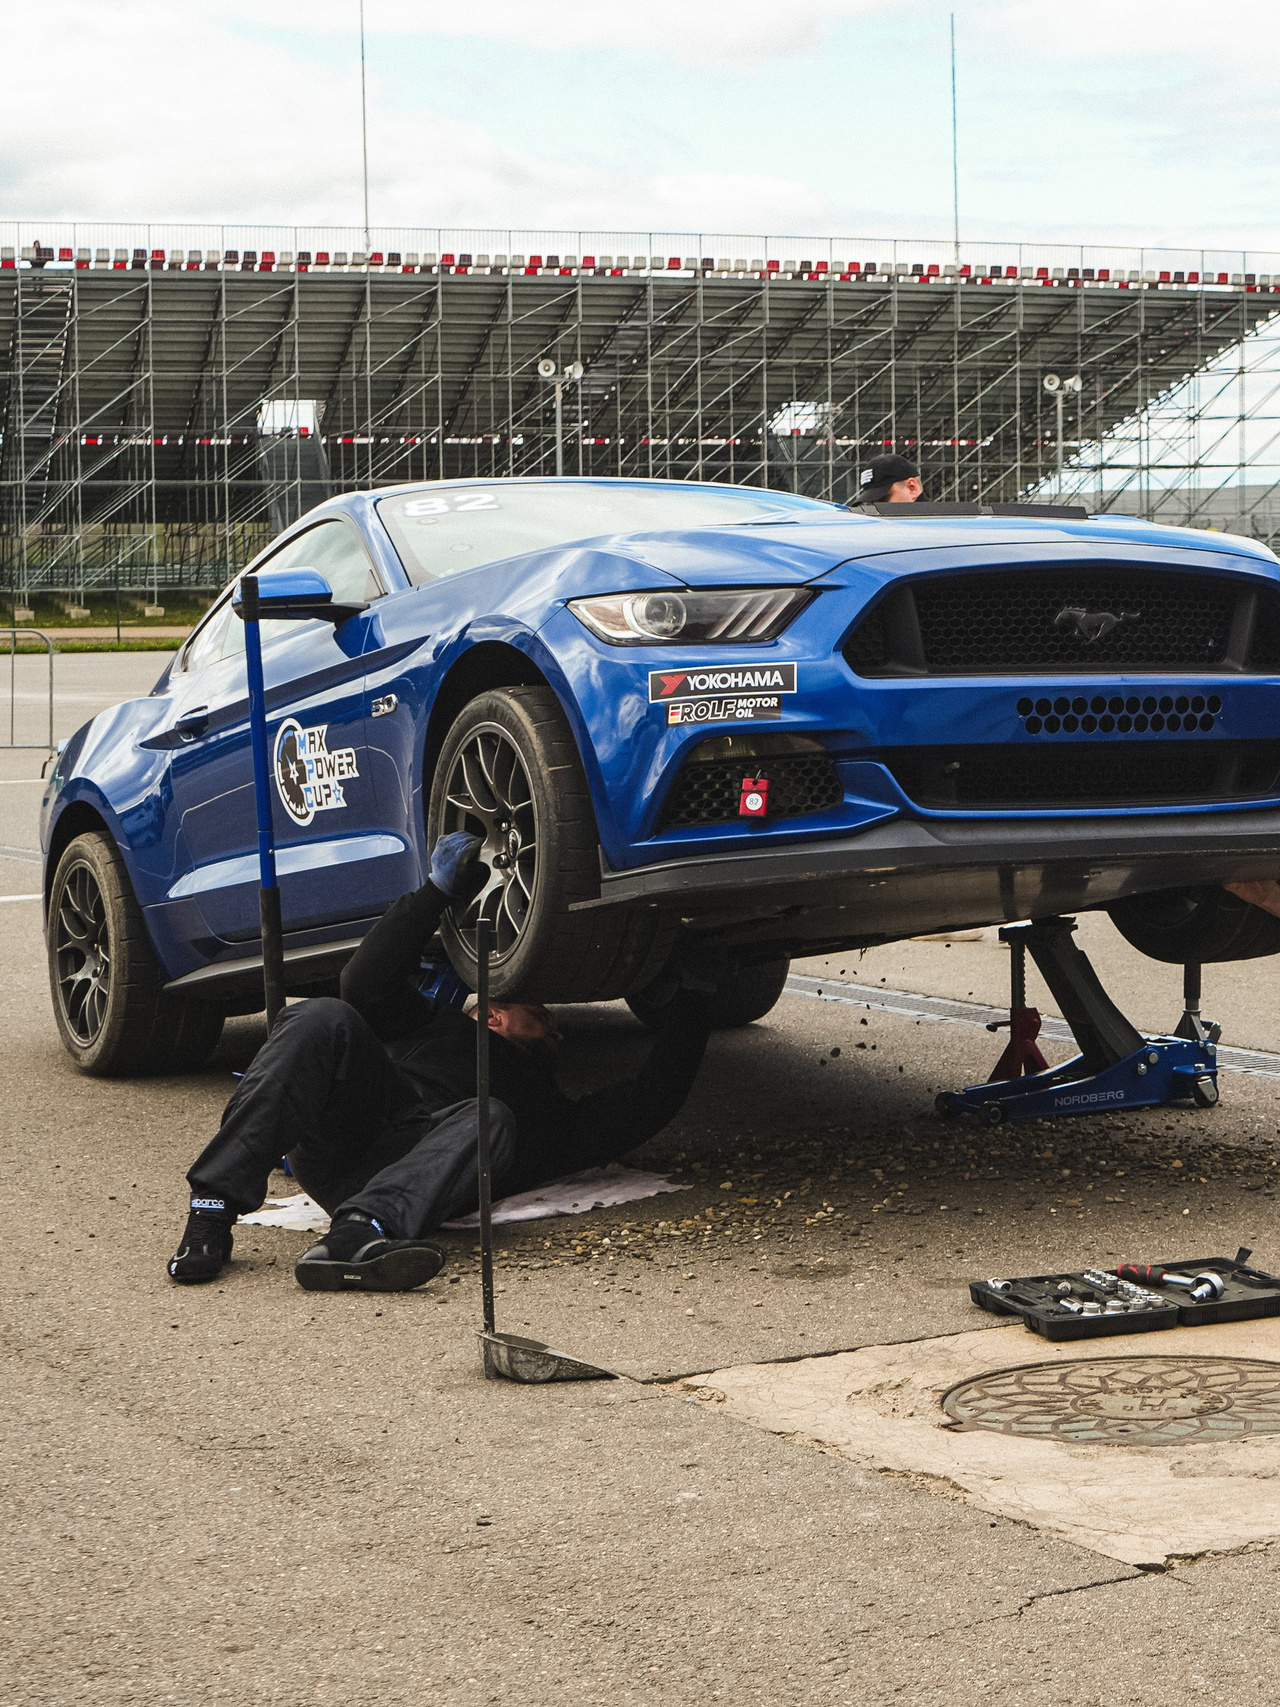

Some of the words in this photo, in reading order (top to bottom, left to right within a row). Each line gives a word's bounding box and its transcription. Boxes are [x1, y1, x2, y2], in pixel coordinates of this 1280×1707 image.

[404, 493, 501, 517] 82
[686, 670, 784, 691] YOKOHAMA
[680, 699, 737, 722] ROLF
[737, 697, 778, 708] MOTOR
[735, 708, 755, 719] OIL
[297, 729, 326, 755] MAX
[306, 752, 356, 781] POWER
[304, 783, 332, 808] CUP
[749, 797, 759, 806] 82
[1054, 1090, 1124, 1107] NORDBERG
